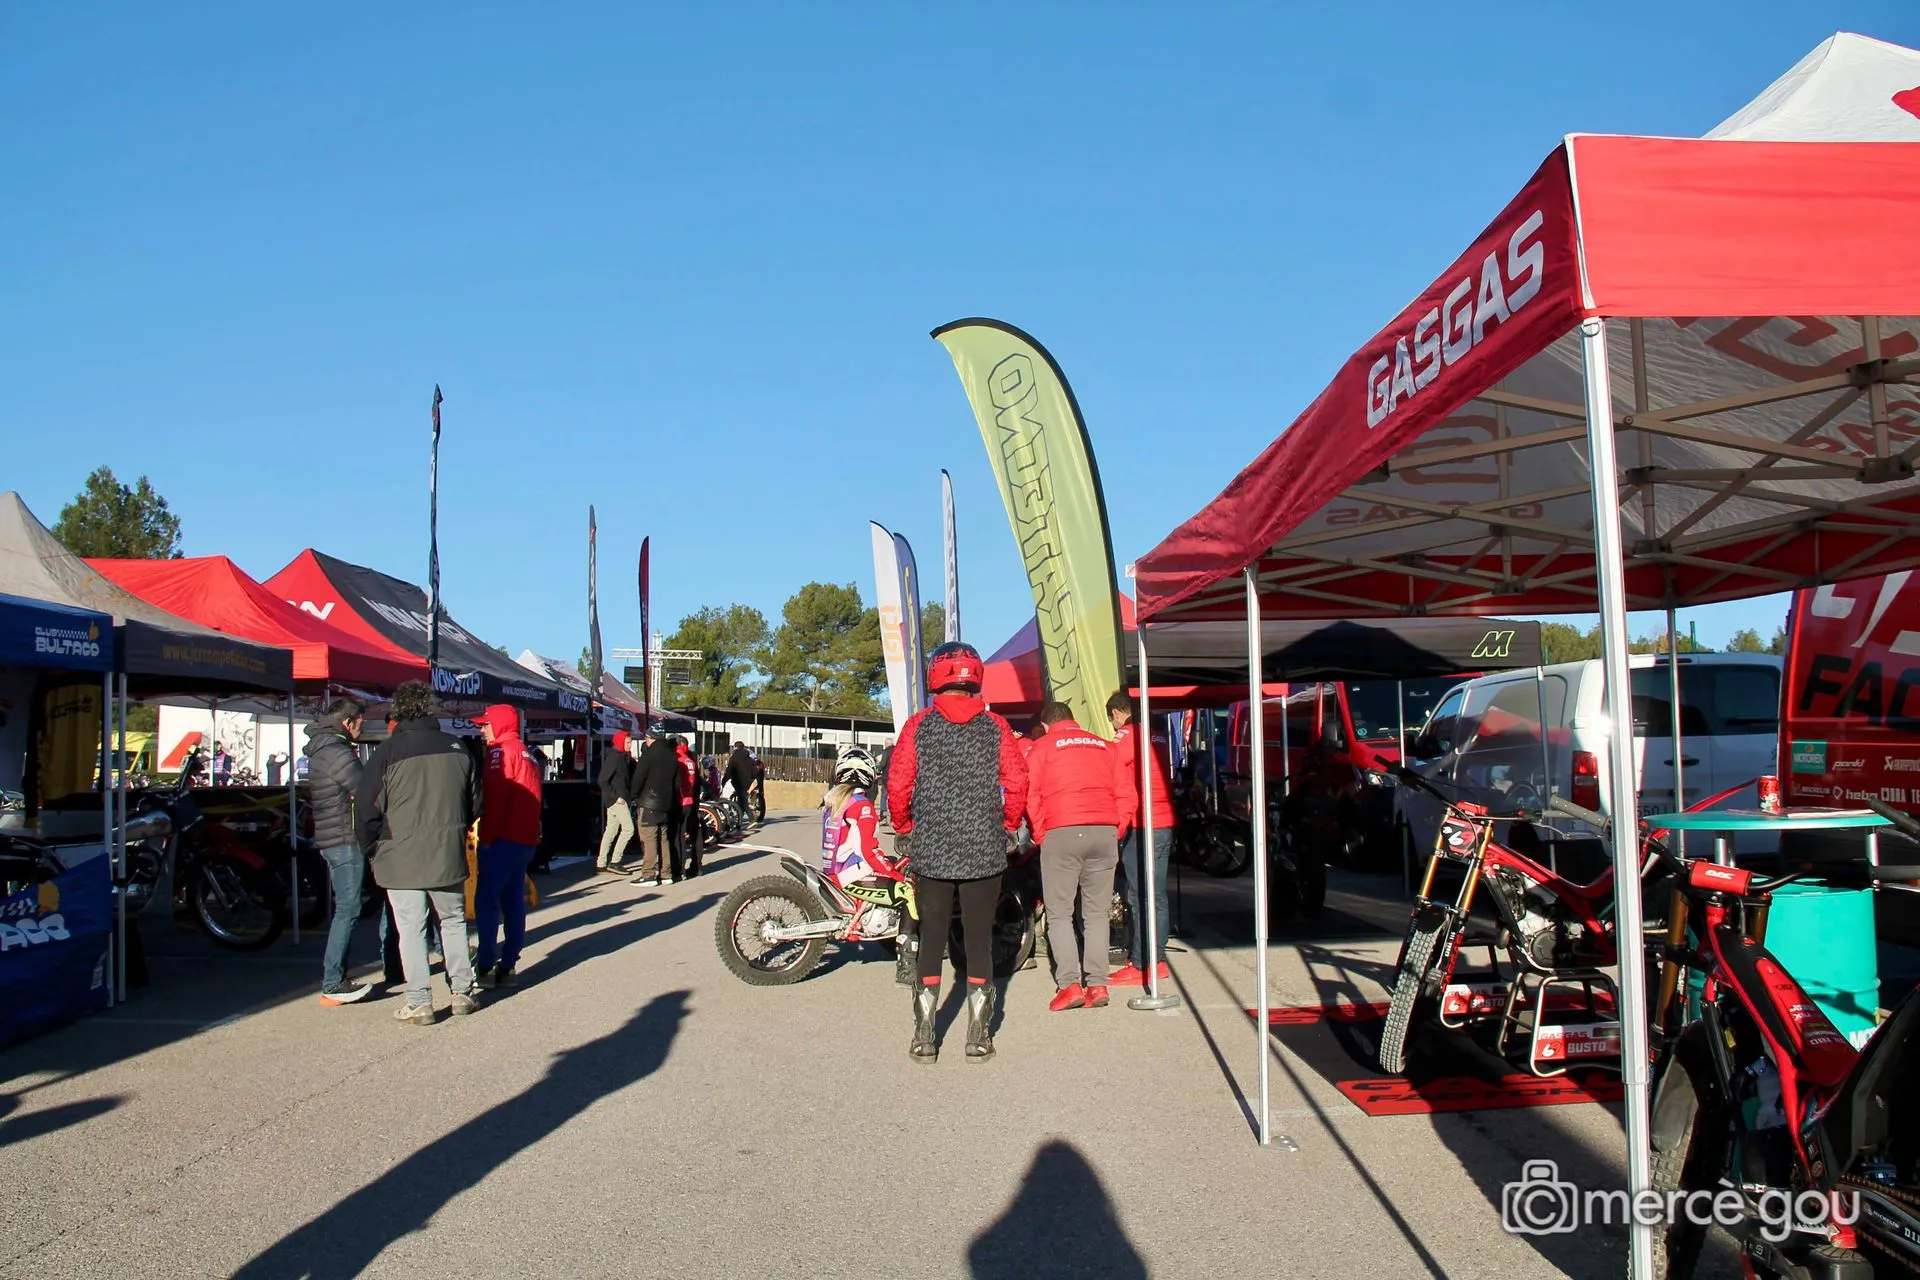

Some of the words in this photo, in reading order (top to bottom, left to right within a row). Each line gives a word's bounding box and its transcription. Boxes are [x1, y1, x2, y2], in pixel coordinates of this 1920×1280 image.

[1366, 209, 1544, 429] GASGAS
[35, 627, 57, 637] CLUB
[36, 637, 99, 657] BULTACO
[1056, 737, 1106, 748] GASGAS
[1567, 1041, 1606, 1053] BUSTO
[1872, 1210, 1900, 1229] MICHELIN
